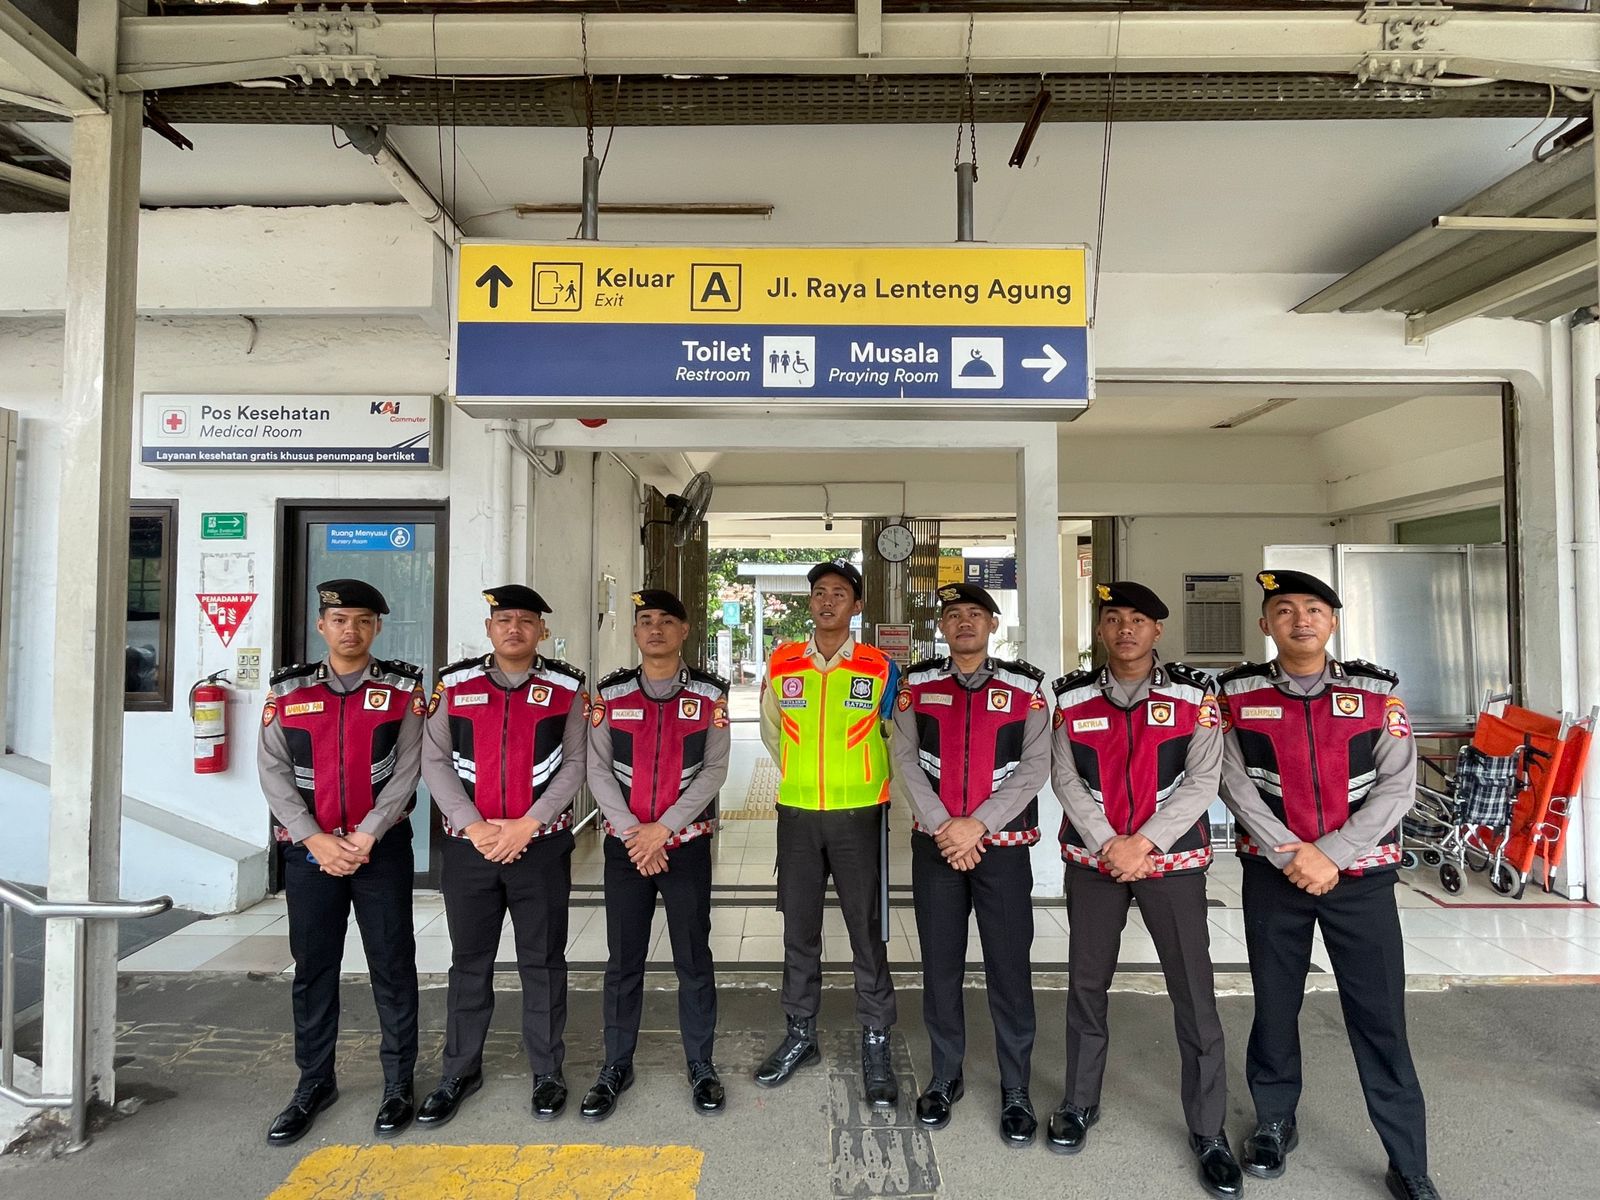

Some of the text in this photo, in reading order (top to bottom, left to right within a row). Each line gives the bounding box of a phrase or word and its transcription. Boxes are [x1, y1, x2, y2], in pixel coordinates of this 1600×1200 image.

[596, 267, 675, 288] Keluar
[701, 271, 732, 303] A
[767, 276, 1071, 305] Jl. Raya Lenteng Agung
[594, 292, 625, 307] Exit
[681, 340, 751, 362] Toilet
[850, 341, 939, 364] Musala
[675, 366, 751, 382] Restroom
[828, 367, 939, 386] Praying Room
[201, 405, 330, 421] Pos Kesehatan
[389, 415, 427, 423] Commuter
[199, 424, 303, 438] Medical Room
[156, 451, 415, 463] Layanan kesehatan gratis khusus penumpang bertiket
[331, 529, 388, 538] Ruang Menyusui
[201, 595, 253, 603] PEMADAM API
[846, 701, 872, 710] SATPAM
[1077, 720, 1103, 729] SATRIA
